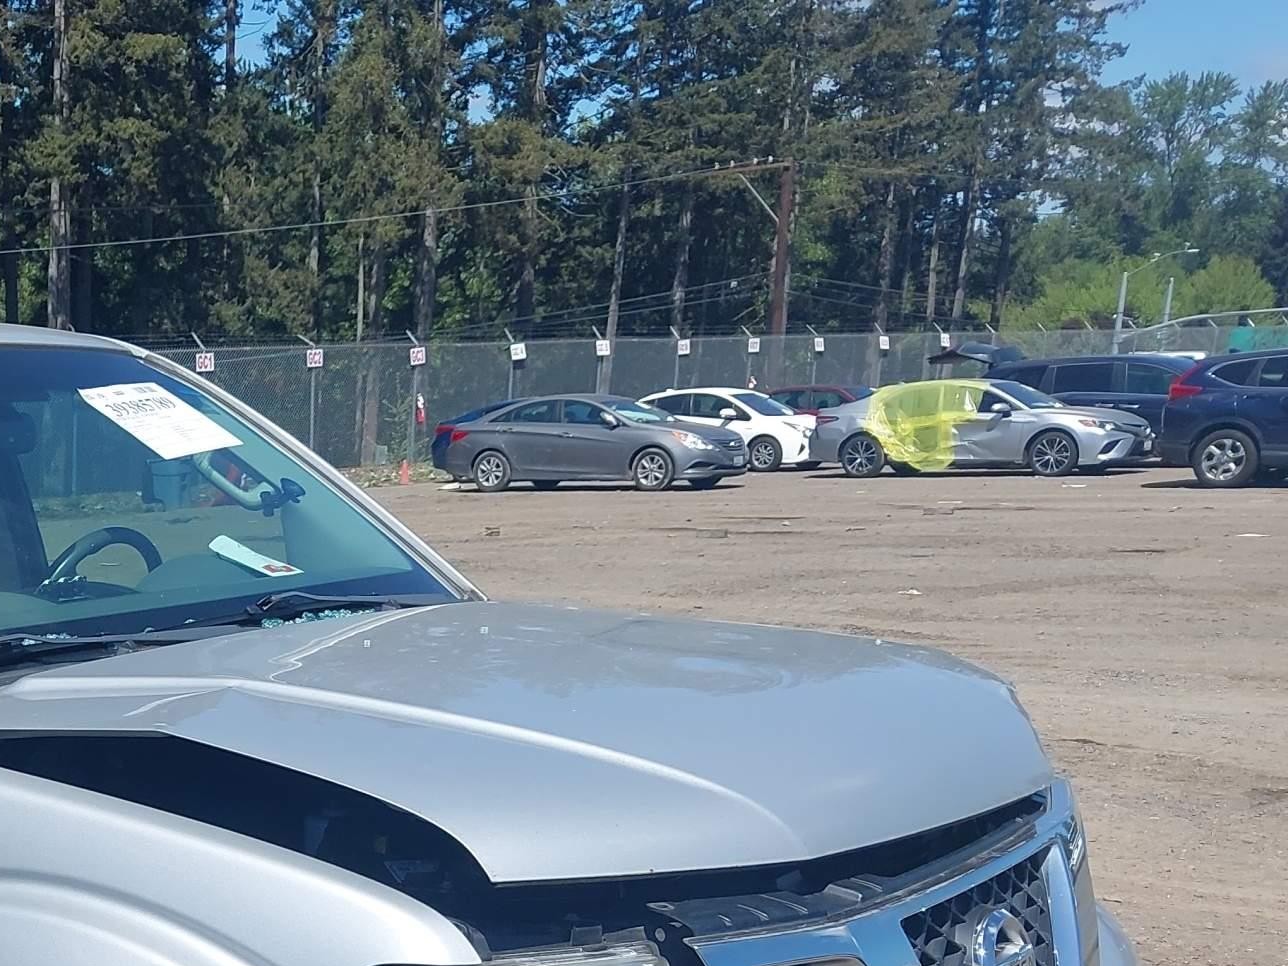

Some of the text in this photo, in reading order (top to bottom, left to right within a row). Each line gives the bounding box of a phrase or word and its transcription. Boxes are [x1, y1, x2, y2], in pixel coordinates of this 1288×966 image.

[197, 354, 214, 370] GC1
[307, 350, 323, 365] GC2
[411, 349, 424, 362] GC3
